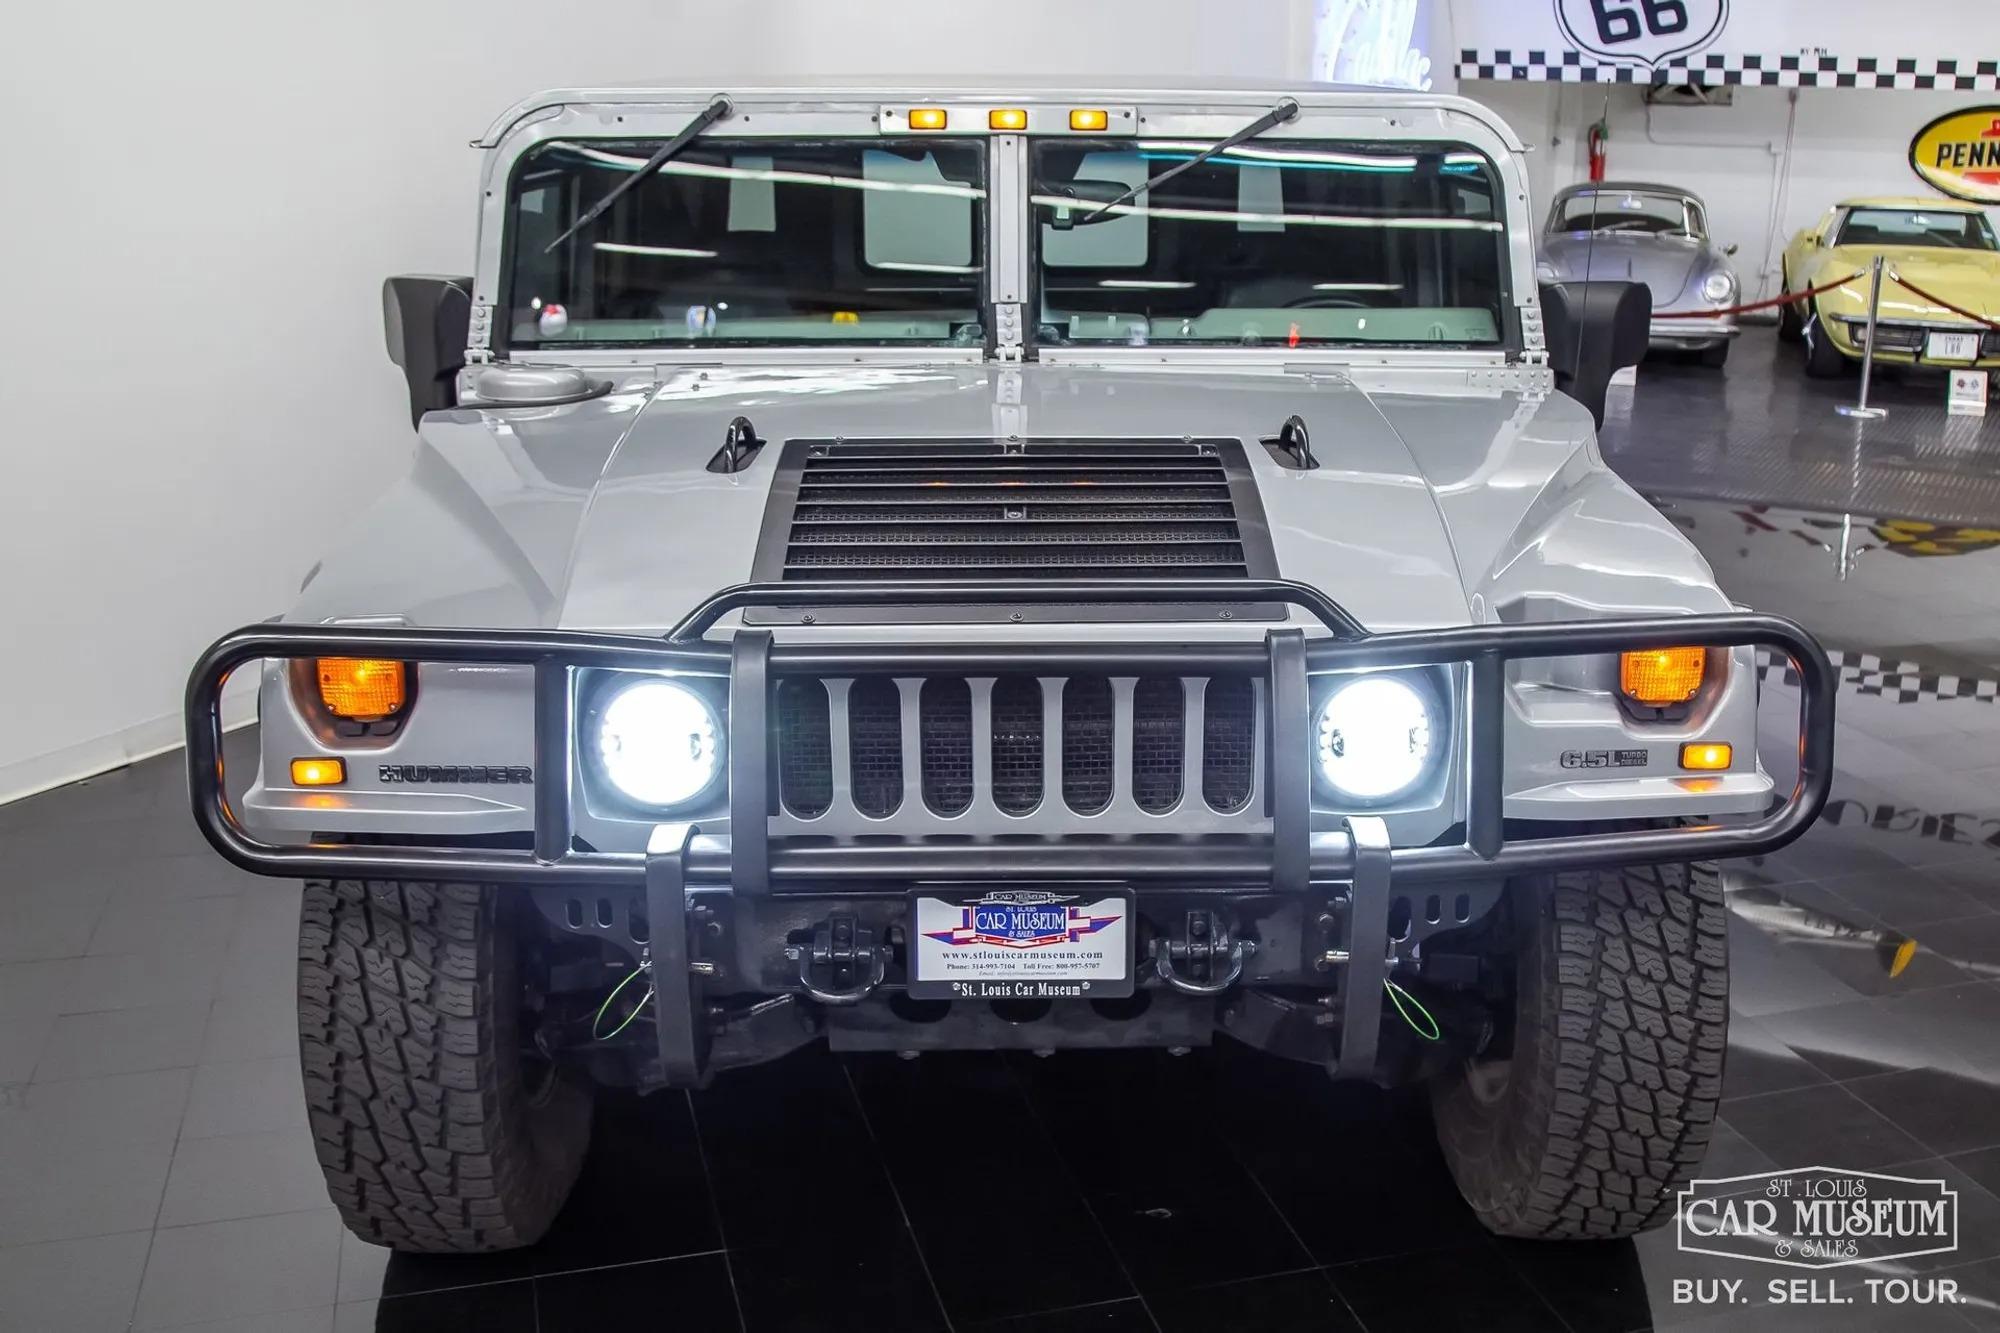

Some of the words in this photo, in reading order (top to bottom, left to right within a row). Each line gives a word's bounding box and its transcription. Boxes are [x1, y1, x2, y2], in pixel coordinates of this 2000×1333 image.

[1590, 0, 1688, 44] 66
[1561, 750, 1621, 769] 6.5L
[379, 765, 534, 784] HUMMER
[976, 912, 1007, 930] CAR
[1011, 912, 1065, 930] MUSEUM
[942, 950, 1103, 960] www.stlouiscarmuseum.com
[962, 982, 976, 996] St.
[981, 982, 1011, 996] Louis
[1015, 982, 1034, 996] Car
[1038, 982, 1081, 996] Museum
